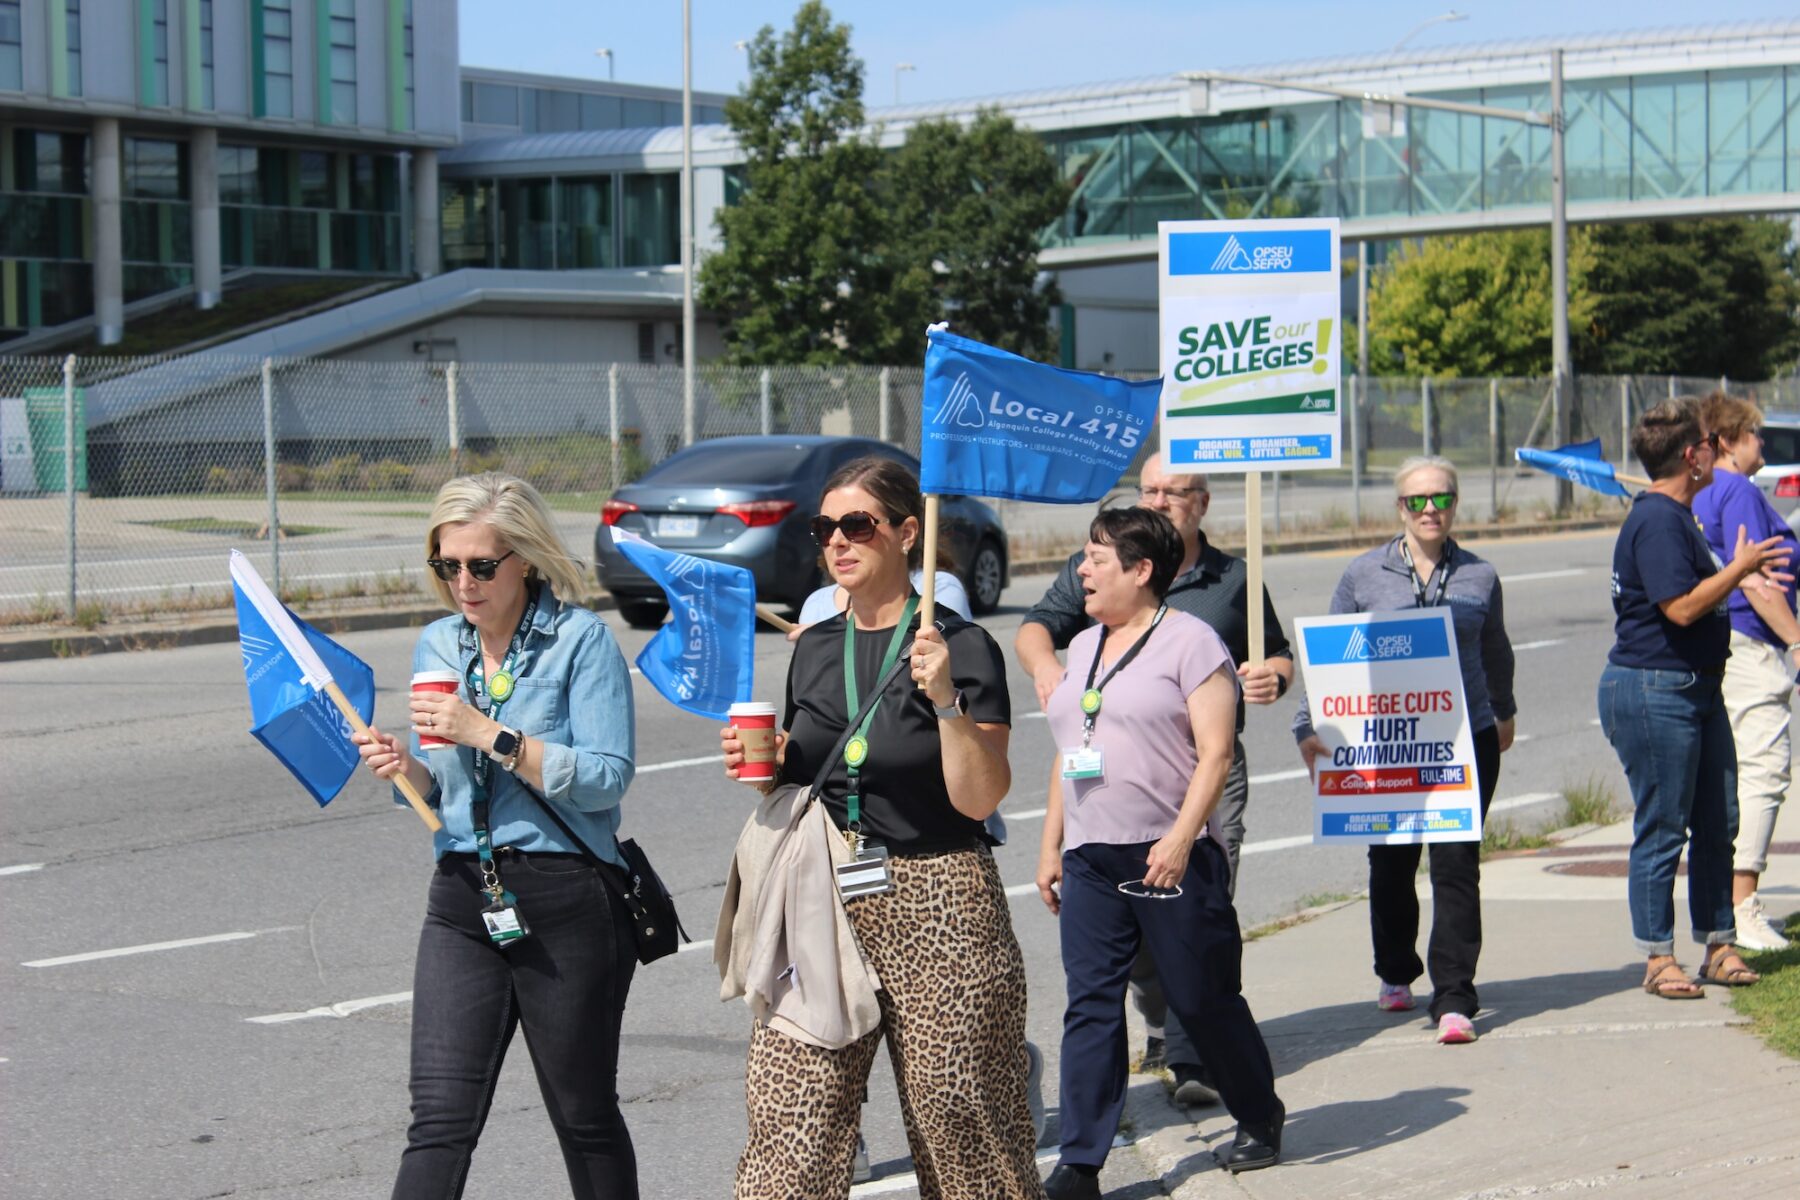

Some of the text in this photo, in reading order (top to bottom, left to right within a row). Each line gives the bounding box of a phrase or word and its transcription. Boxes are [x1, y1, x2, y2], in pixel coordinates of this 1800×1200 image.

[1253, 246, 1293, 259] OPSEU
[1253, 258, 1292, 270] SEFPO
[1178, 316, 1311, 356] SAVE our
[989, 391, 1140, 449] Local 415
[1095, 405, 1144, 426] OPSEU
[988, 419, 1128, 460] Algonquin College Faculty Union
[1376, 635, 1412, 646] OPSEU
[1378, 645, 1412, 658] SEFPO
[1322, 690, 1453, 717] COLLEGE CUTS
[1364, 717, 1420, 742] HURT
[1334, 742, 1454, 766] COMMUNITIES
[1340, 778, 1413, 791] College Support
[1421, 768, 1462, 784] FULL-TIME
